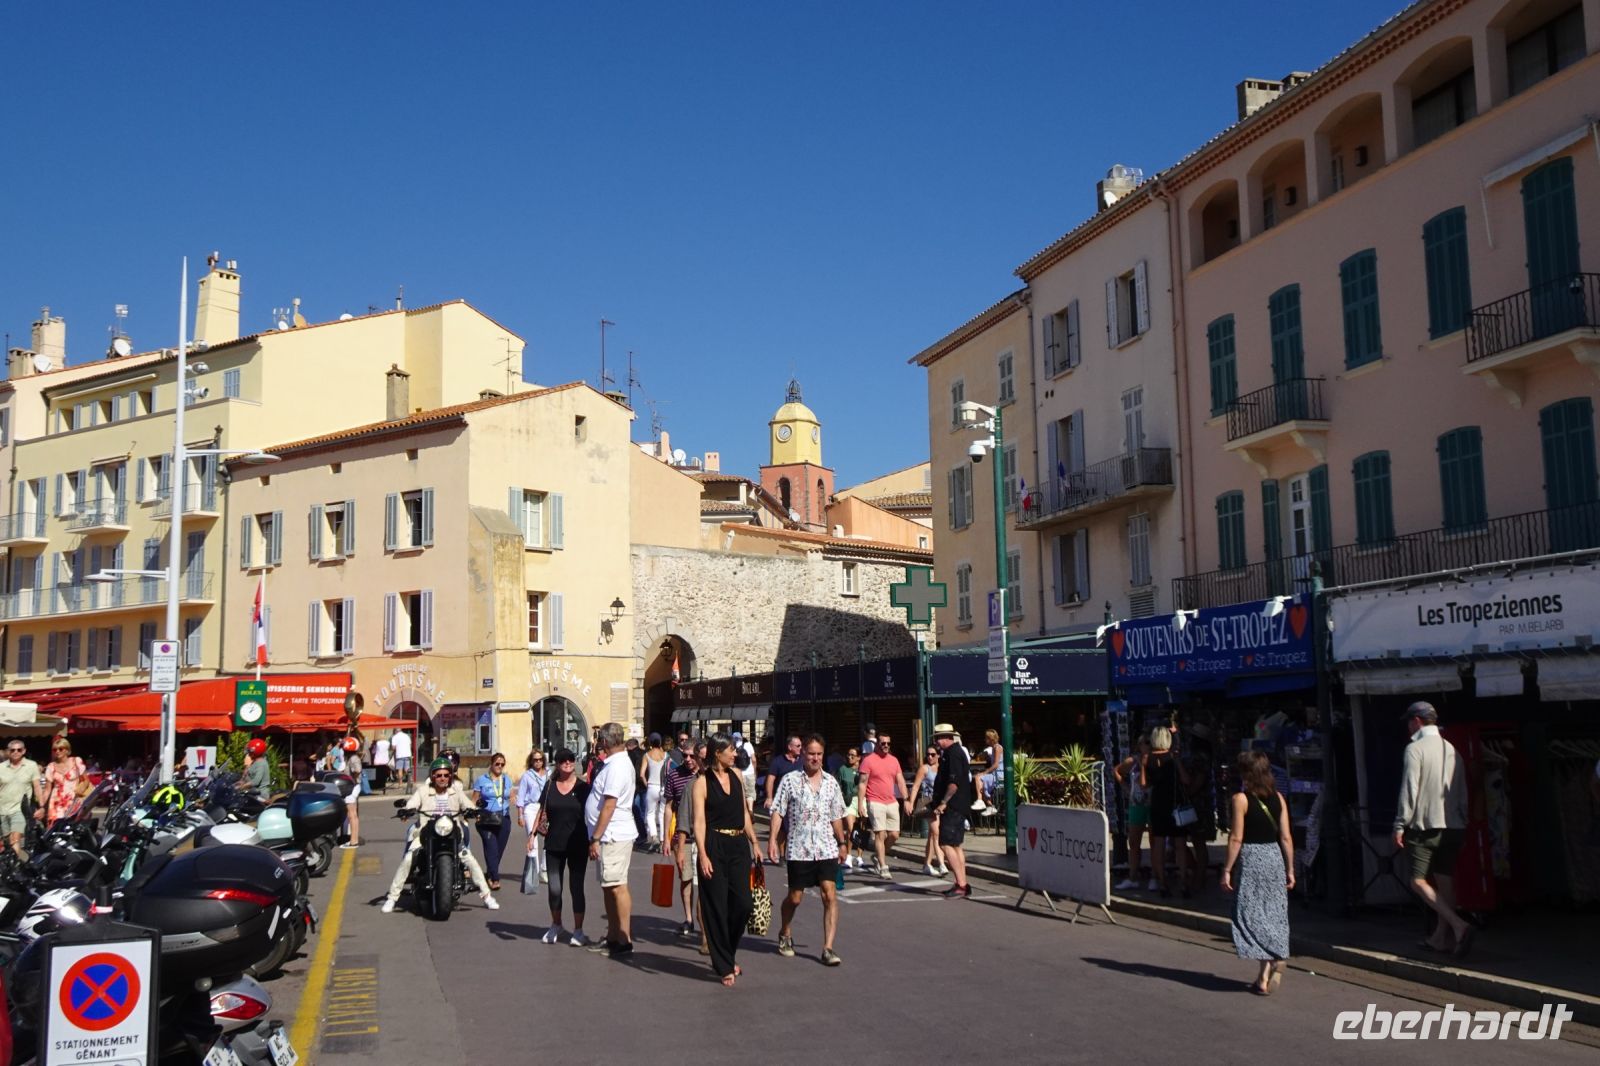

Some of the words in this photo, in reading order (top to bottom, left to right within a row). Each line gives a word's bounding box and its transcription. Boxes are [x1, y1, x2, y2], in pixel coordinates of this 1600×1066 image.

[991, 599, 999, 621] P
[1417, 604, 1445, 627] Les
[1446, 594, 1563, 628] Tropeziennes
[1125, 620, 1194, 660] SOUVENIRS
[1195, 625, 1210, 647] DE
[1211, 610, 1288, 652] ST-TROPEZ
[1498, 623, 1515, 635] PAR
[1015, 670, 1031, 678] Bar
[1020, 677, 1039, 685] Port
[373, 671, 446, 706] TOURISME
[1021, 826, 1027, 851] I
[55, 1034, 139, 1050] STATIONNEMENT
[75, 1048, 117, 1060] GÊNANT
